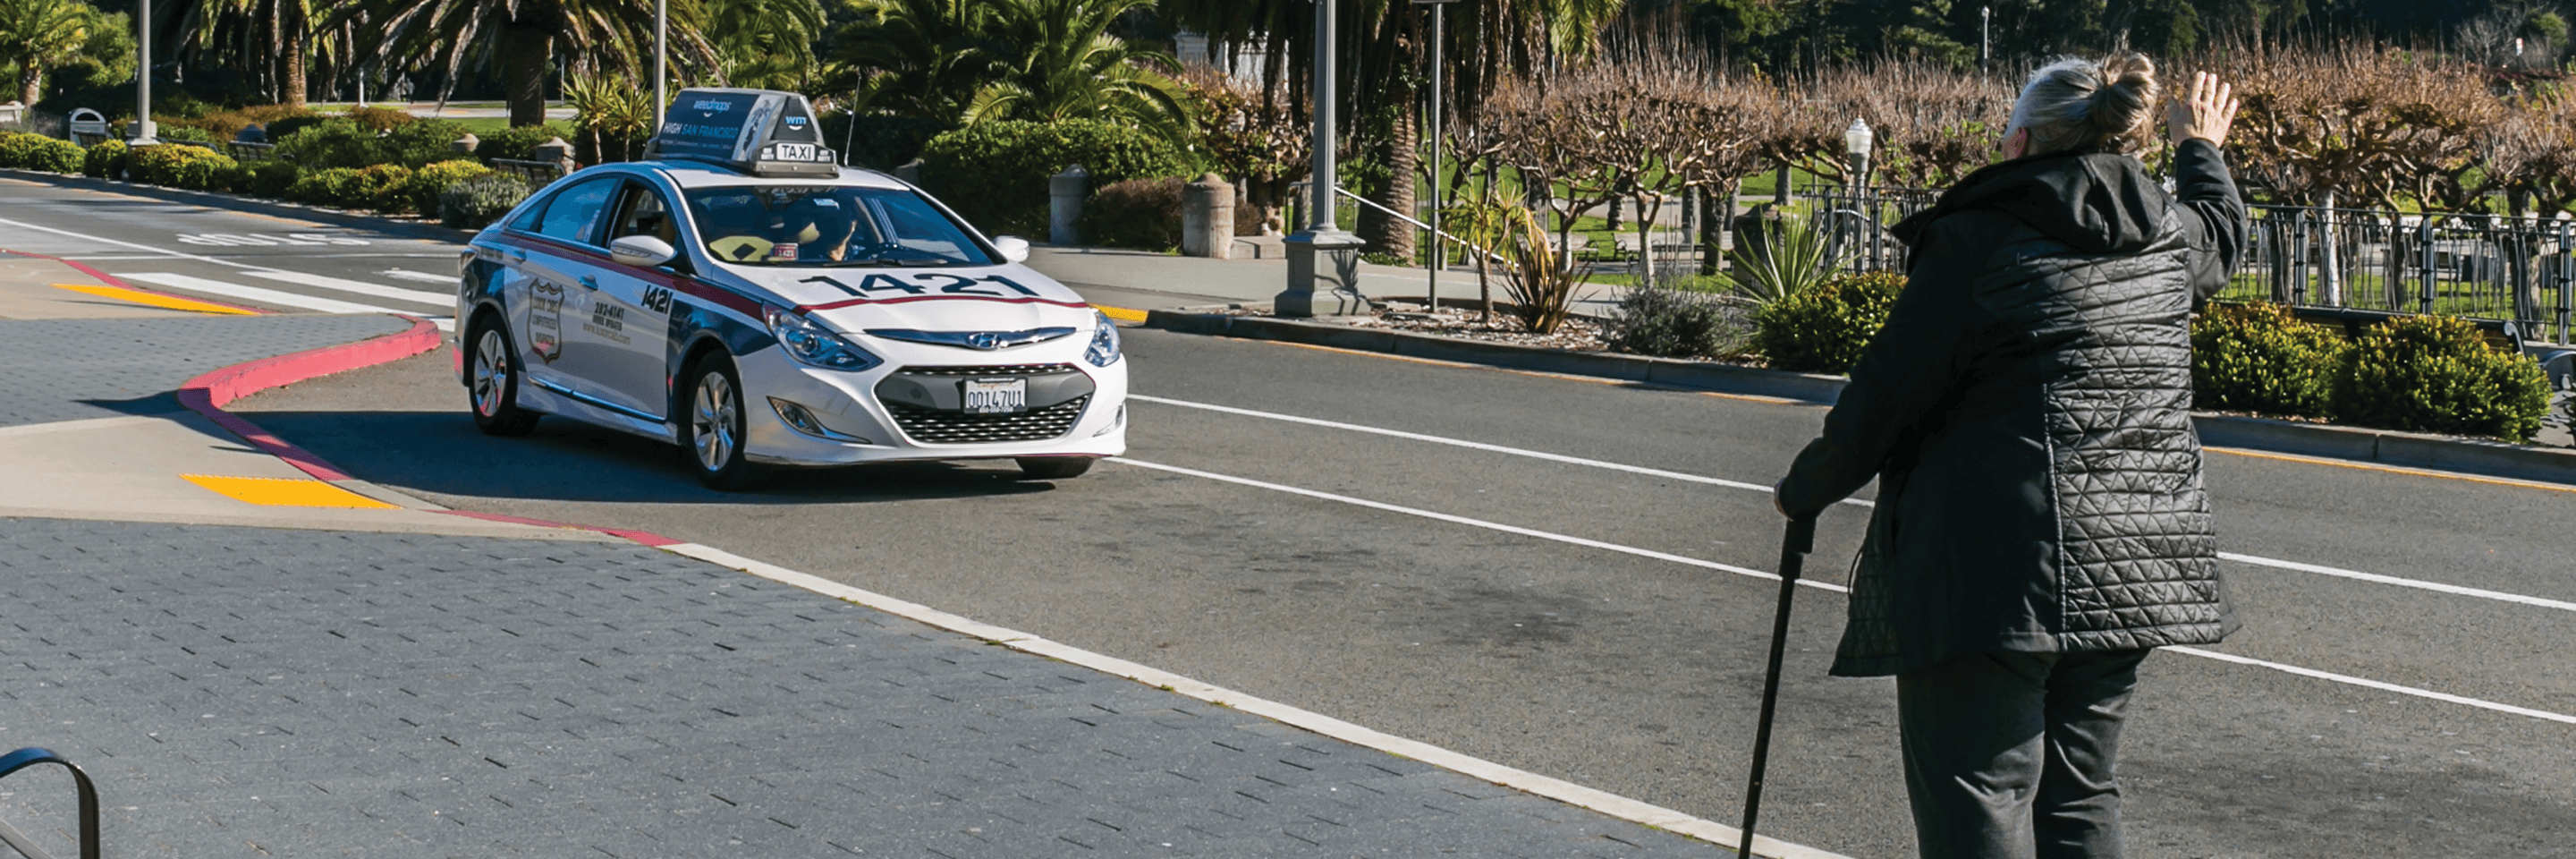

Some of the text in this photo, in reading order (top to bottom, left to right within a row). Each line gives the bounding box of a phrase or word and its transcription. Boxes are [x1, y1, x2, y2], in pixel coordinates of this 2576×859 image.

[782, 145, 811, 160] TAXI
[797, 273, 1041, 298] 1421
[641, 285, 674, 314] 1421
